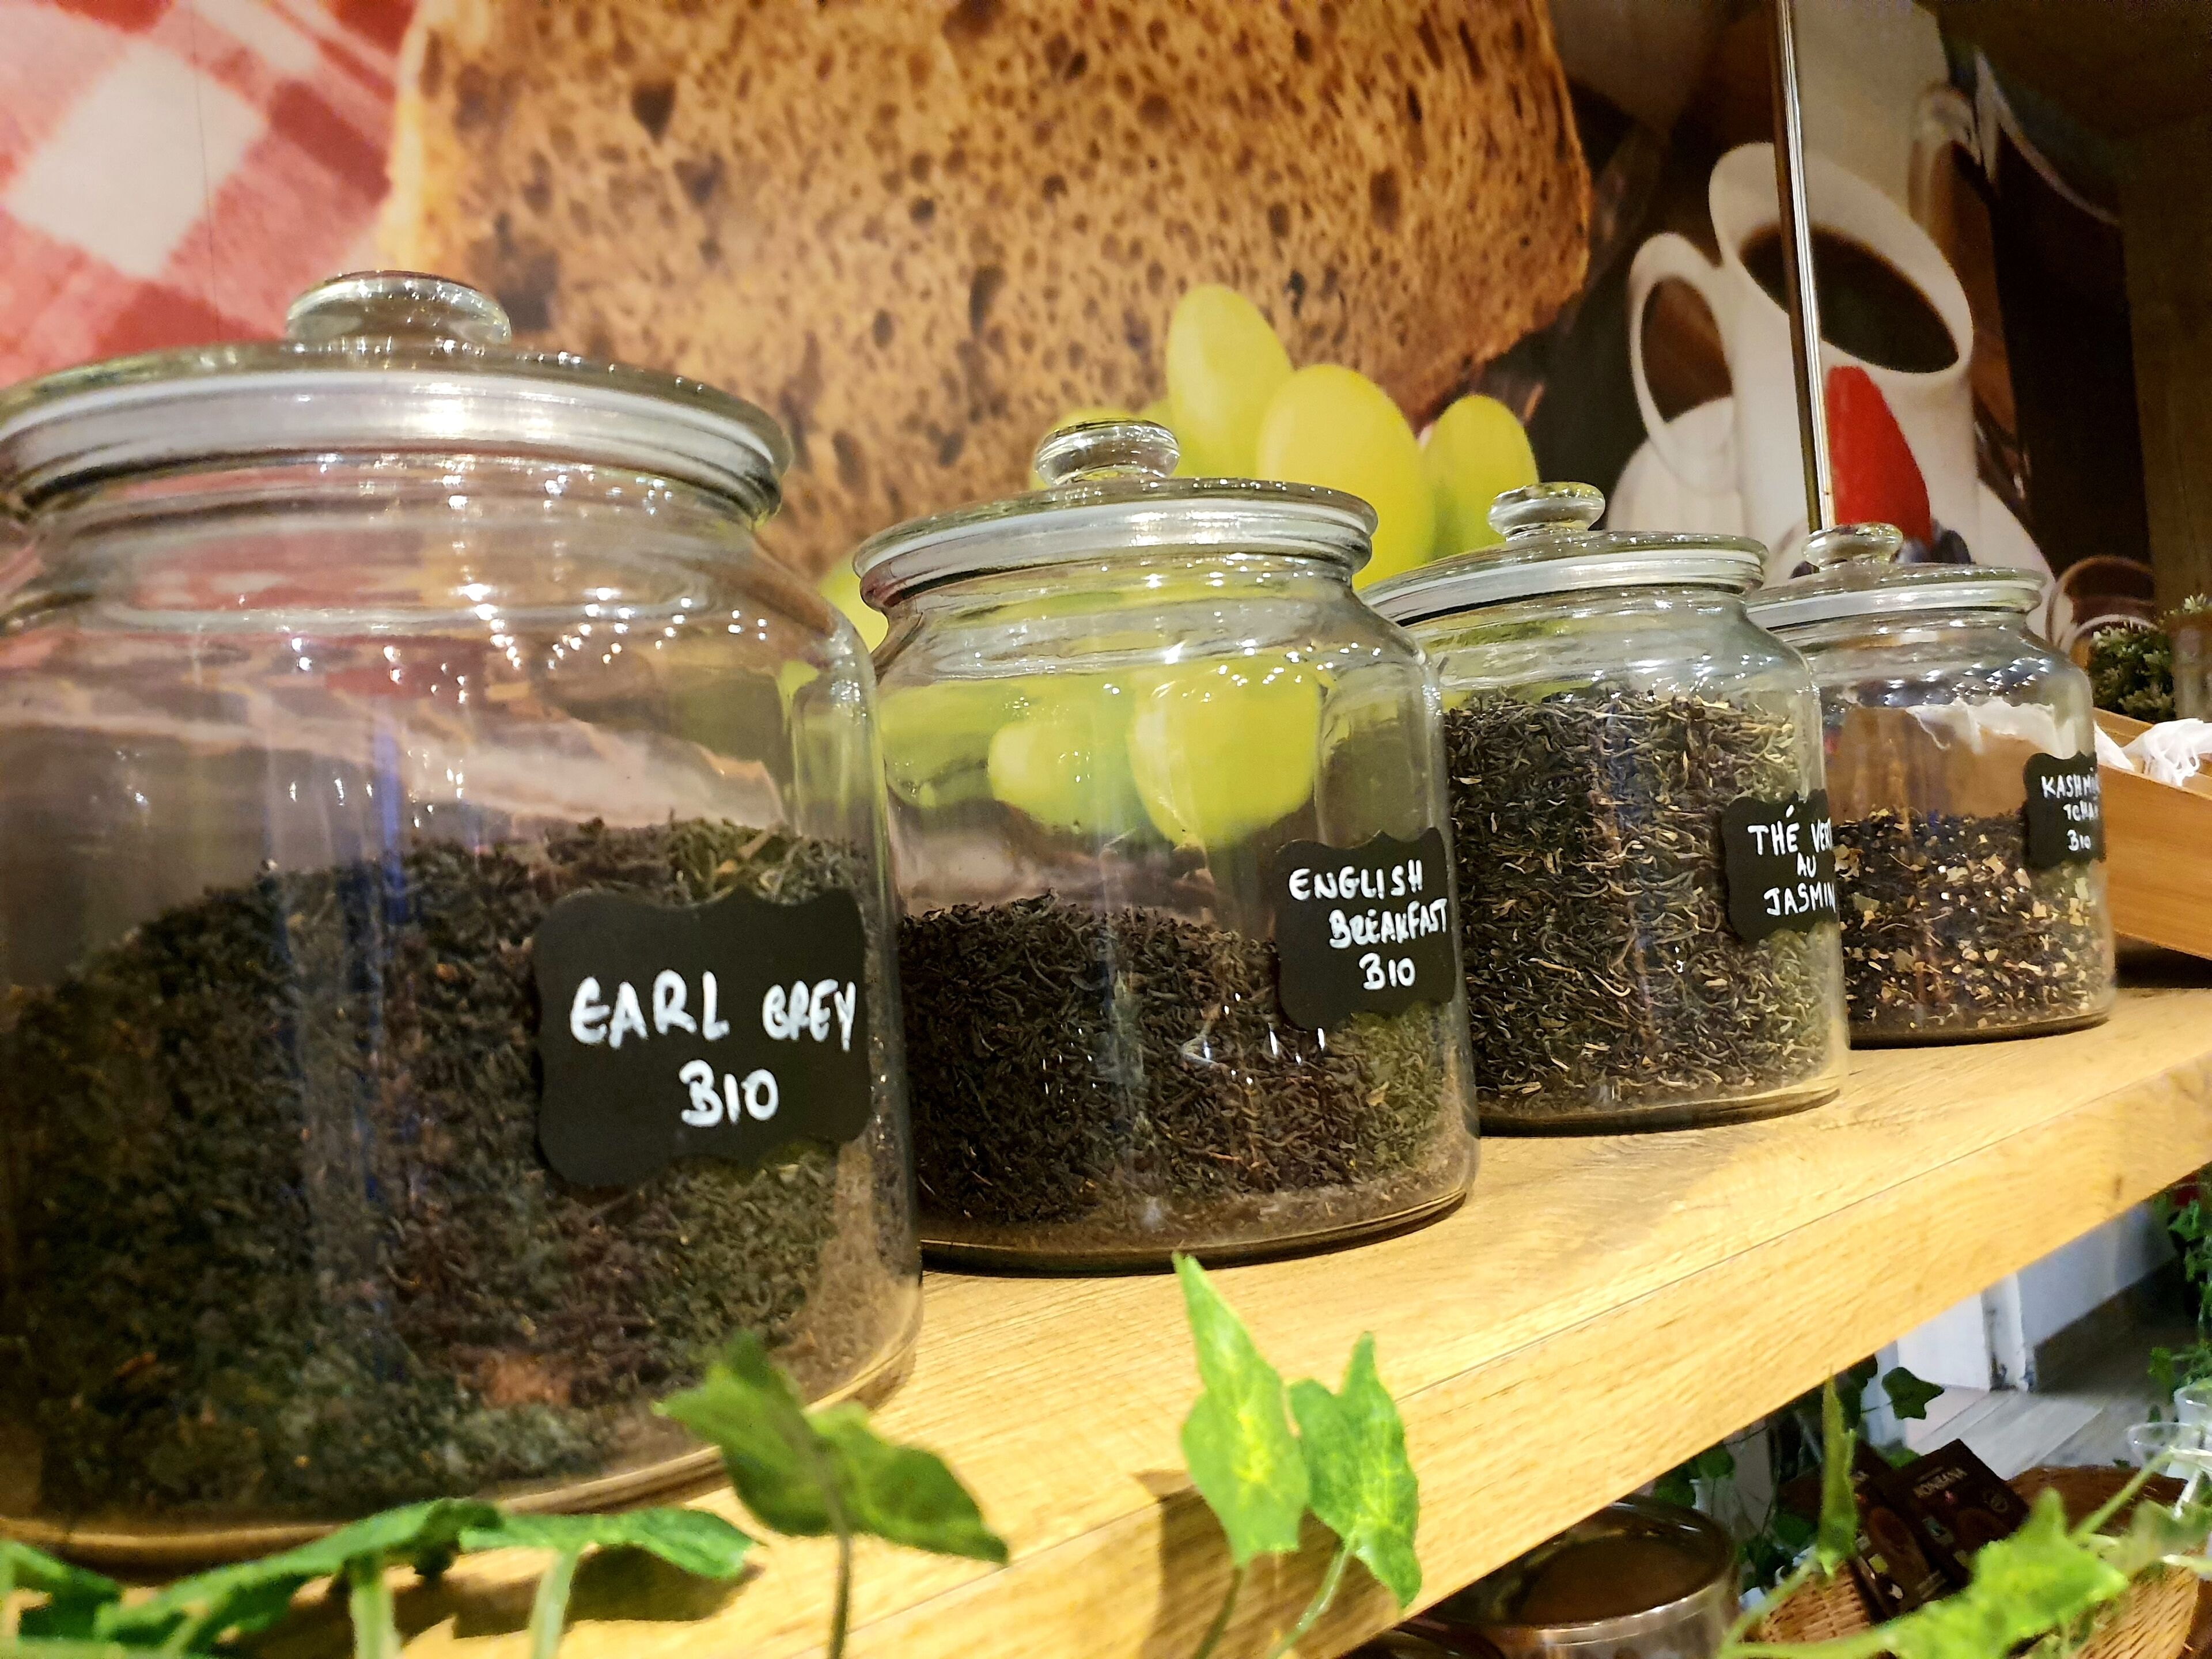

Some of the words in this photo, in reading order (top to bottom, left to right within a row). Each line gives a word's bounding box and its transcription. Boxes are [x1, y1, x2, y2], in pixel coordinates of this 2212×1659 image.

[1747, 805, 1800, 856] THÉ
[1289, 859, 1423, 901] ENGLISH
[1797, 851, 1817, 878] AU
[1763, 881, 1836, 916] JASMIN
[1358, 952, 1416, 990] BIO
[570, 969, 730, 1050] EARL
[762, 979, 857, 1052] GREY
[679, 1059, 779, 1128] BIO
